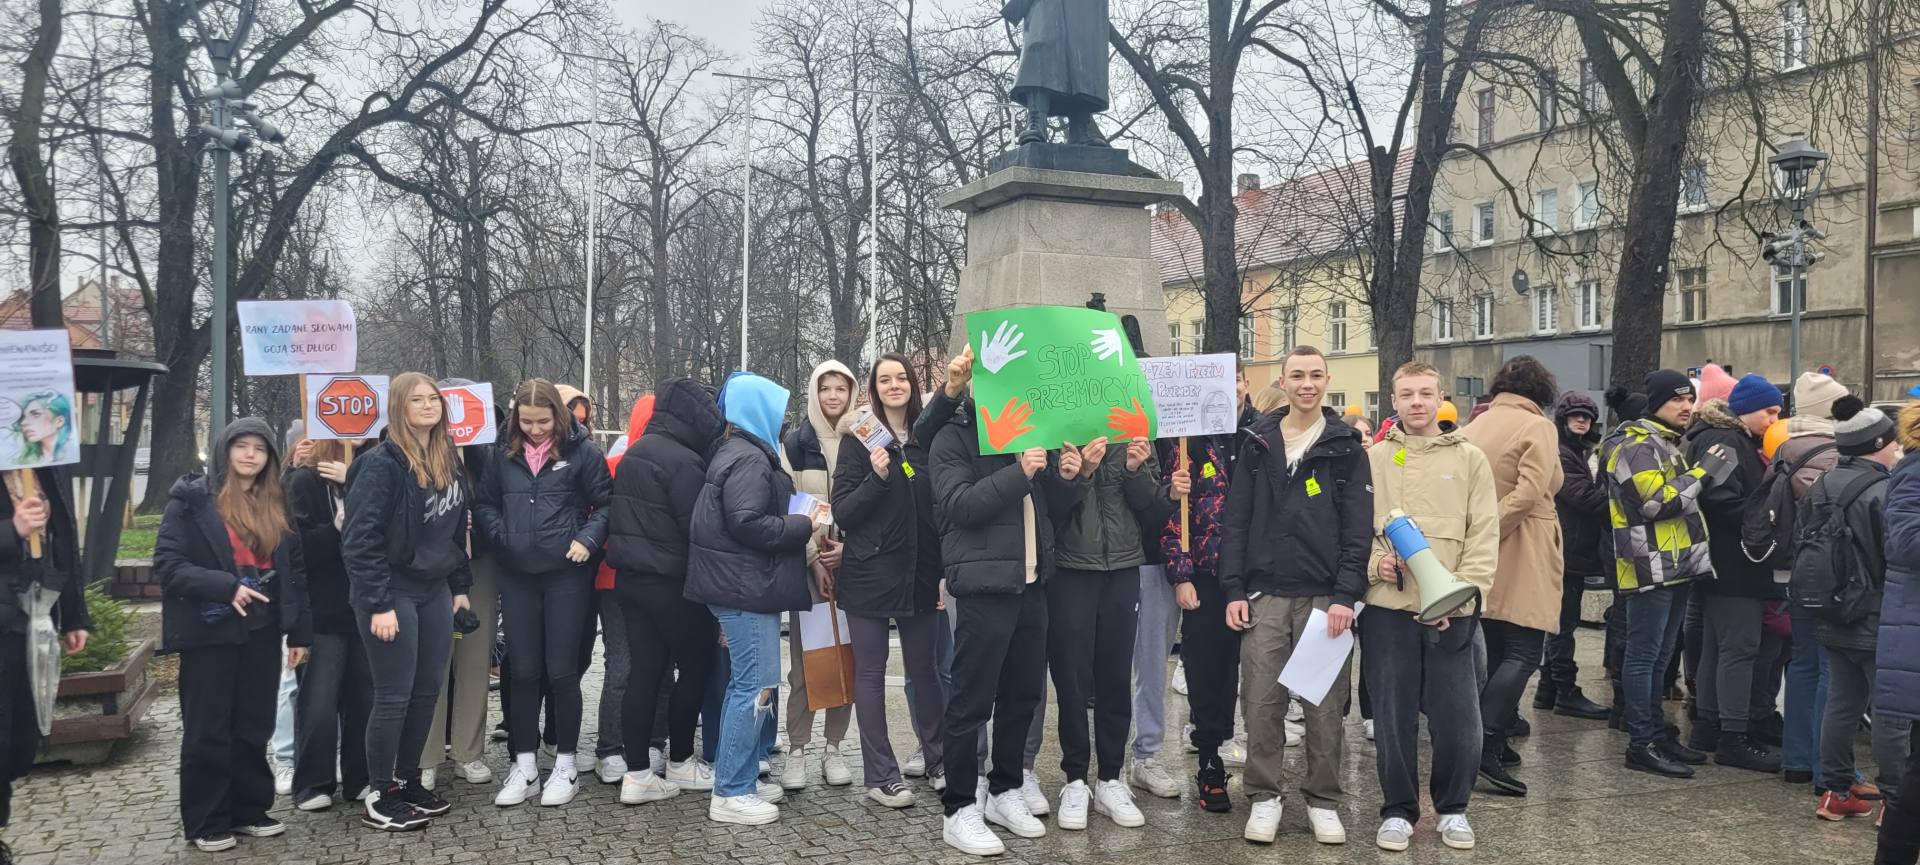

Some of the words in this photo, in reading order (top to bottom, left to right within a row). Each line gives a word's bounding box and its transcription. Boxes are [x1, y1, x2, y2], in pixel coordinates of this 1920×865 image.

[245, 325, 268, 335] RANY
[271, 324, 307, 334] ZADANE
[311, 323, 353, 333] SŁOWAMI
[306, 343, 338, 353] DŁUGO
[1038, 342, 1092, 380] STOP
[322, 395, 374, 415] STOP
[446, 426, 474, 438] TOP
